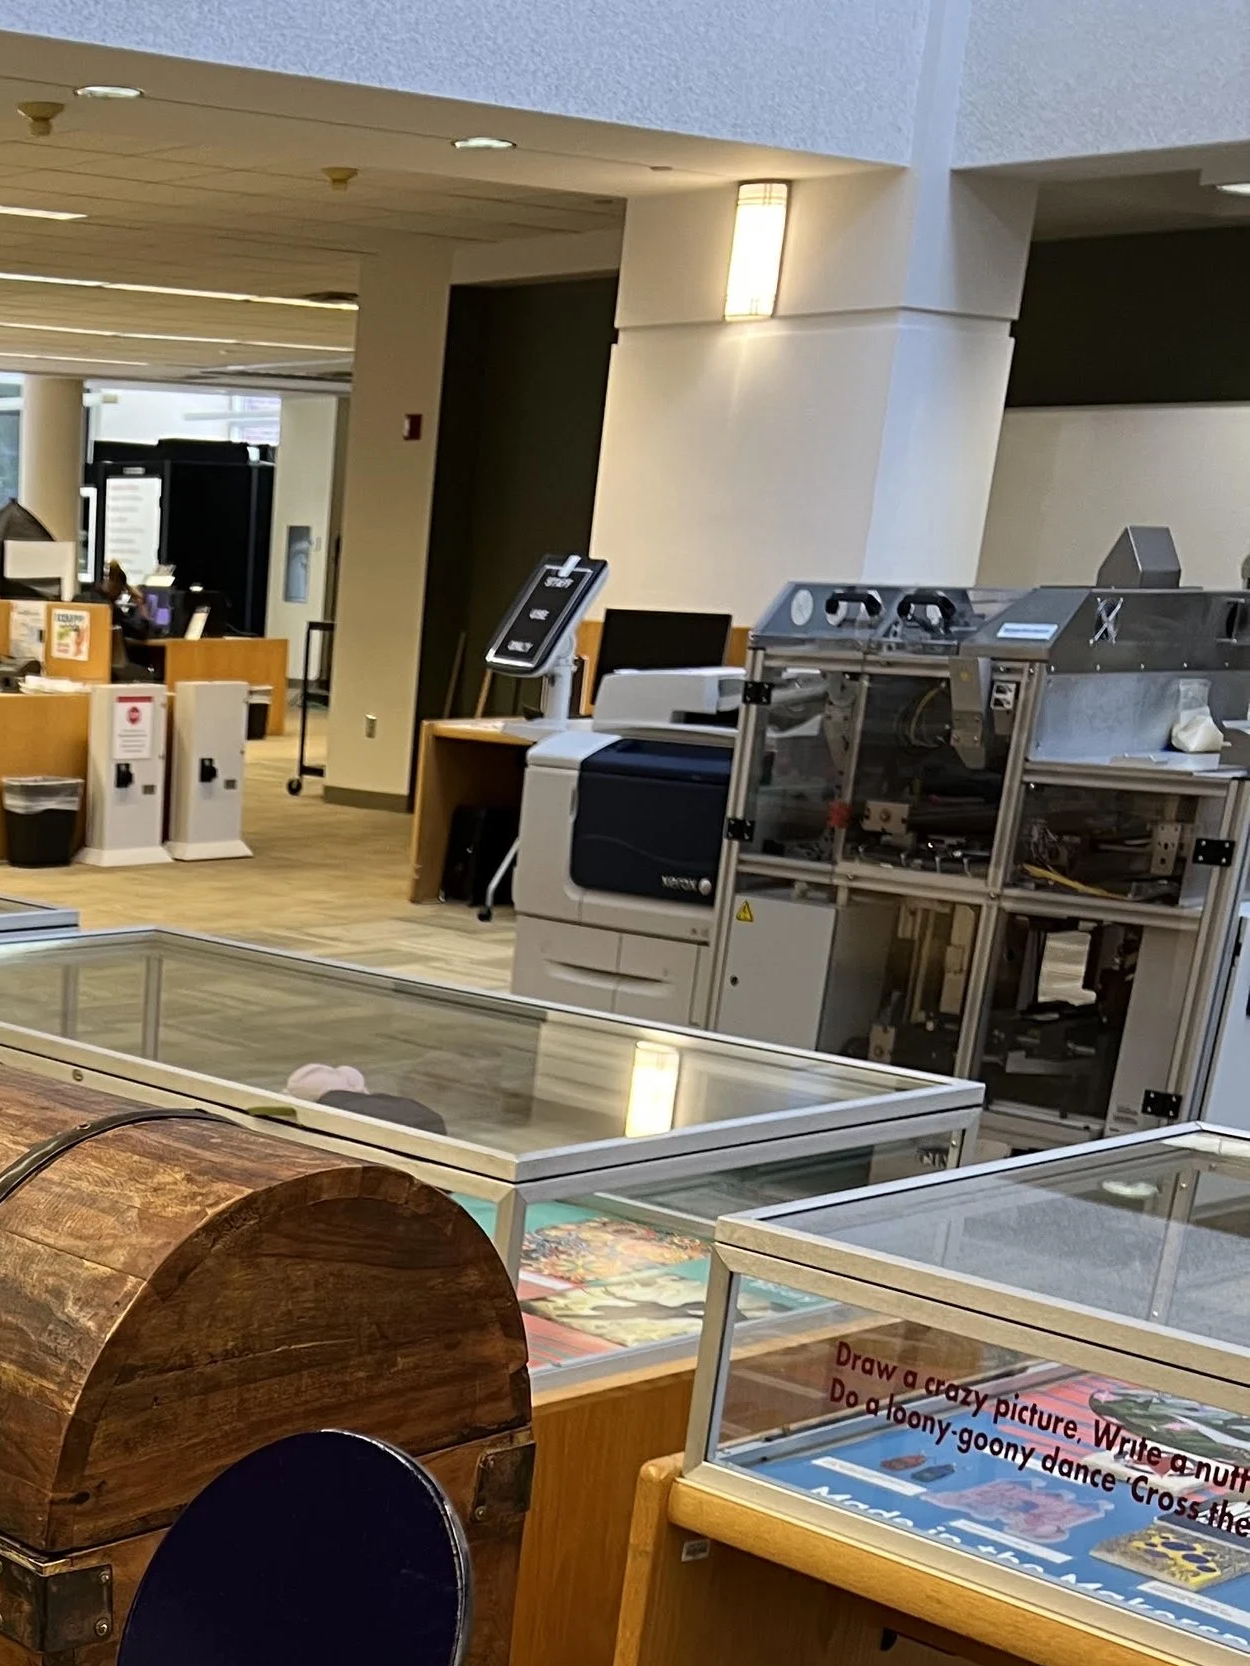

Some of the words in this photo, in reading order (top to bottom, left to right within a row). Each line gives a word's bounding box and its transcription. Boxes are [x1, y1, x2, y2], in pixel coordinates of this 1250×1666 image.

[829, 1377, 859, 1408] Do
[865, 1396, 879, 1416] a
[886, 1393, 1036, 1471] loony-goony
[1041, 1446, 1116, 1492] dance
[1208, 1499, 1250, 1538] the
[835, 1340, 898, 1382] Draw
[903, 1369, 918, 1389] a
[924, 1376, 989, 1417] crazy
[1094, 1419, 1162, 1467] Write
[1170, 1454, 1187, 1474] a
[1194, 1460, 1250, 1502] nutt
